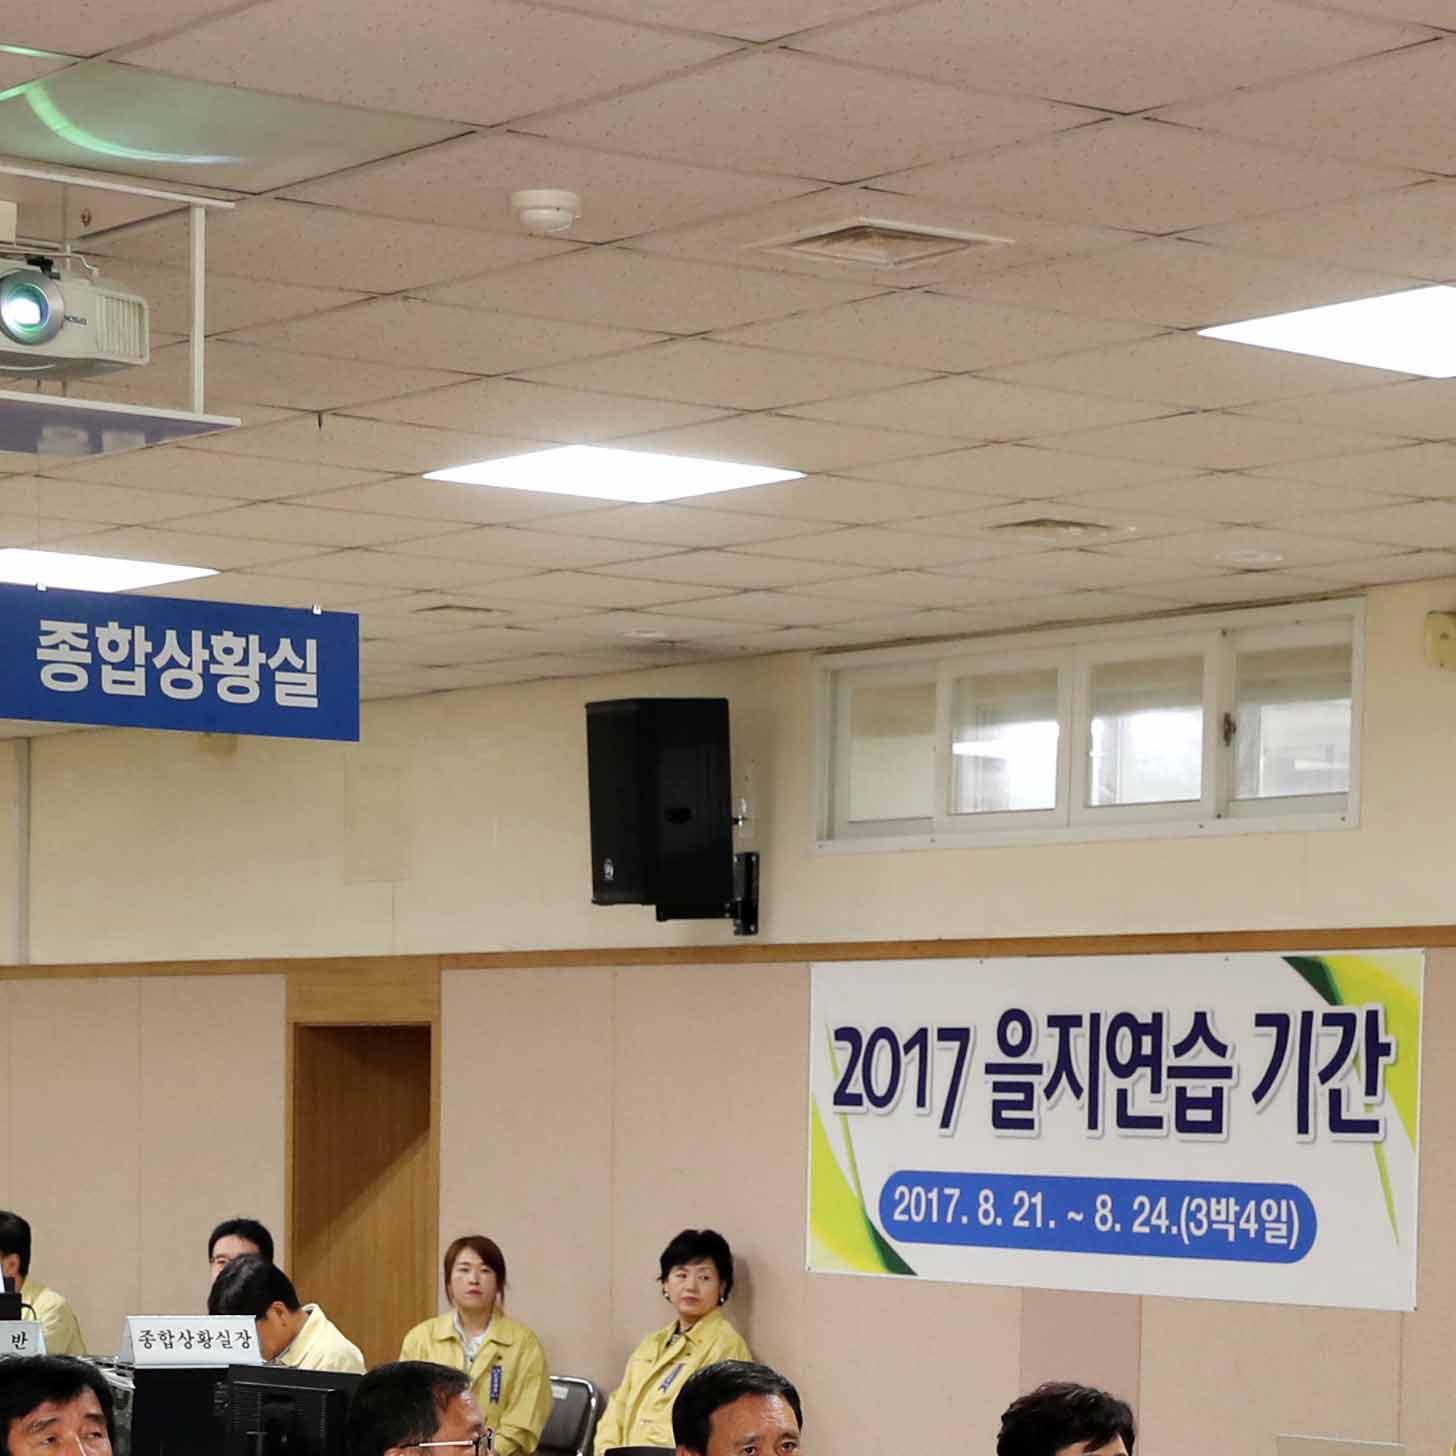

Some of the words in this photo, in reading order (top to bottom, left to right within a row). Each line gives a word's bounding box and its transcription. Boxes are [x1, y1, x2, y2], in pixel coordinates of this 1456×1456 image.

[35, 619, 319, 709] 종합상황실
[832, 1025, 972, 1131] 2017
[984, 1007, 1233, 1135] 을지연습
[1251, 1009, 1392, 1135] 기간
[893, 1185, 968, 1226] 2017.
[978, 1189, 1002, 1227] 8.
[1012, 1191, 1055, 1230] 21.
[1094, 1196, 1122, 1233] 8.
[138, 1328, 252, 1351] 종합상황실장
